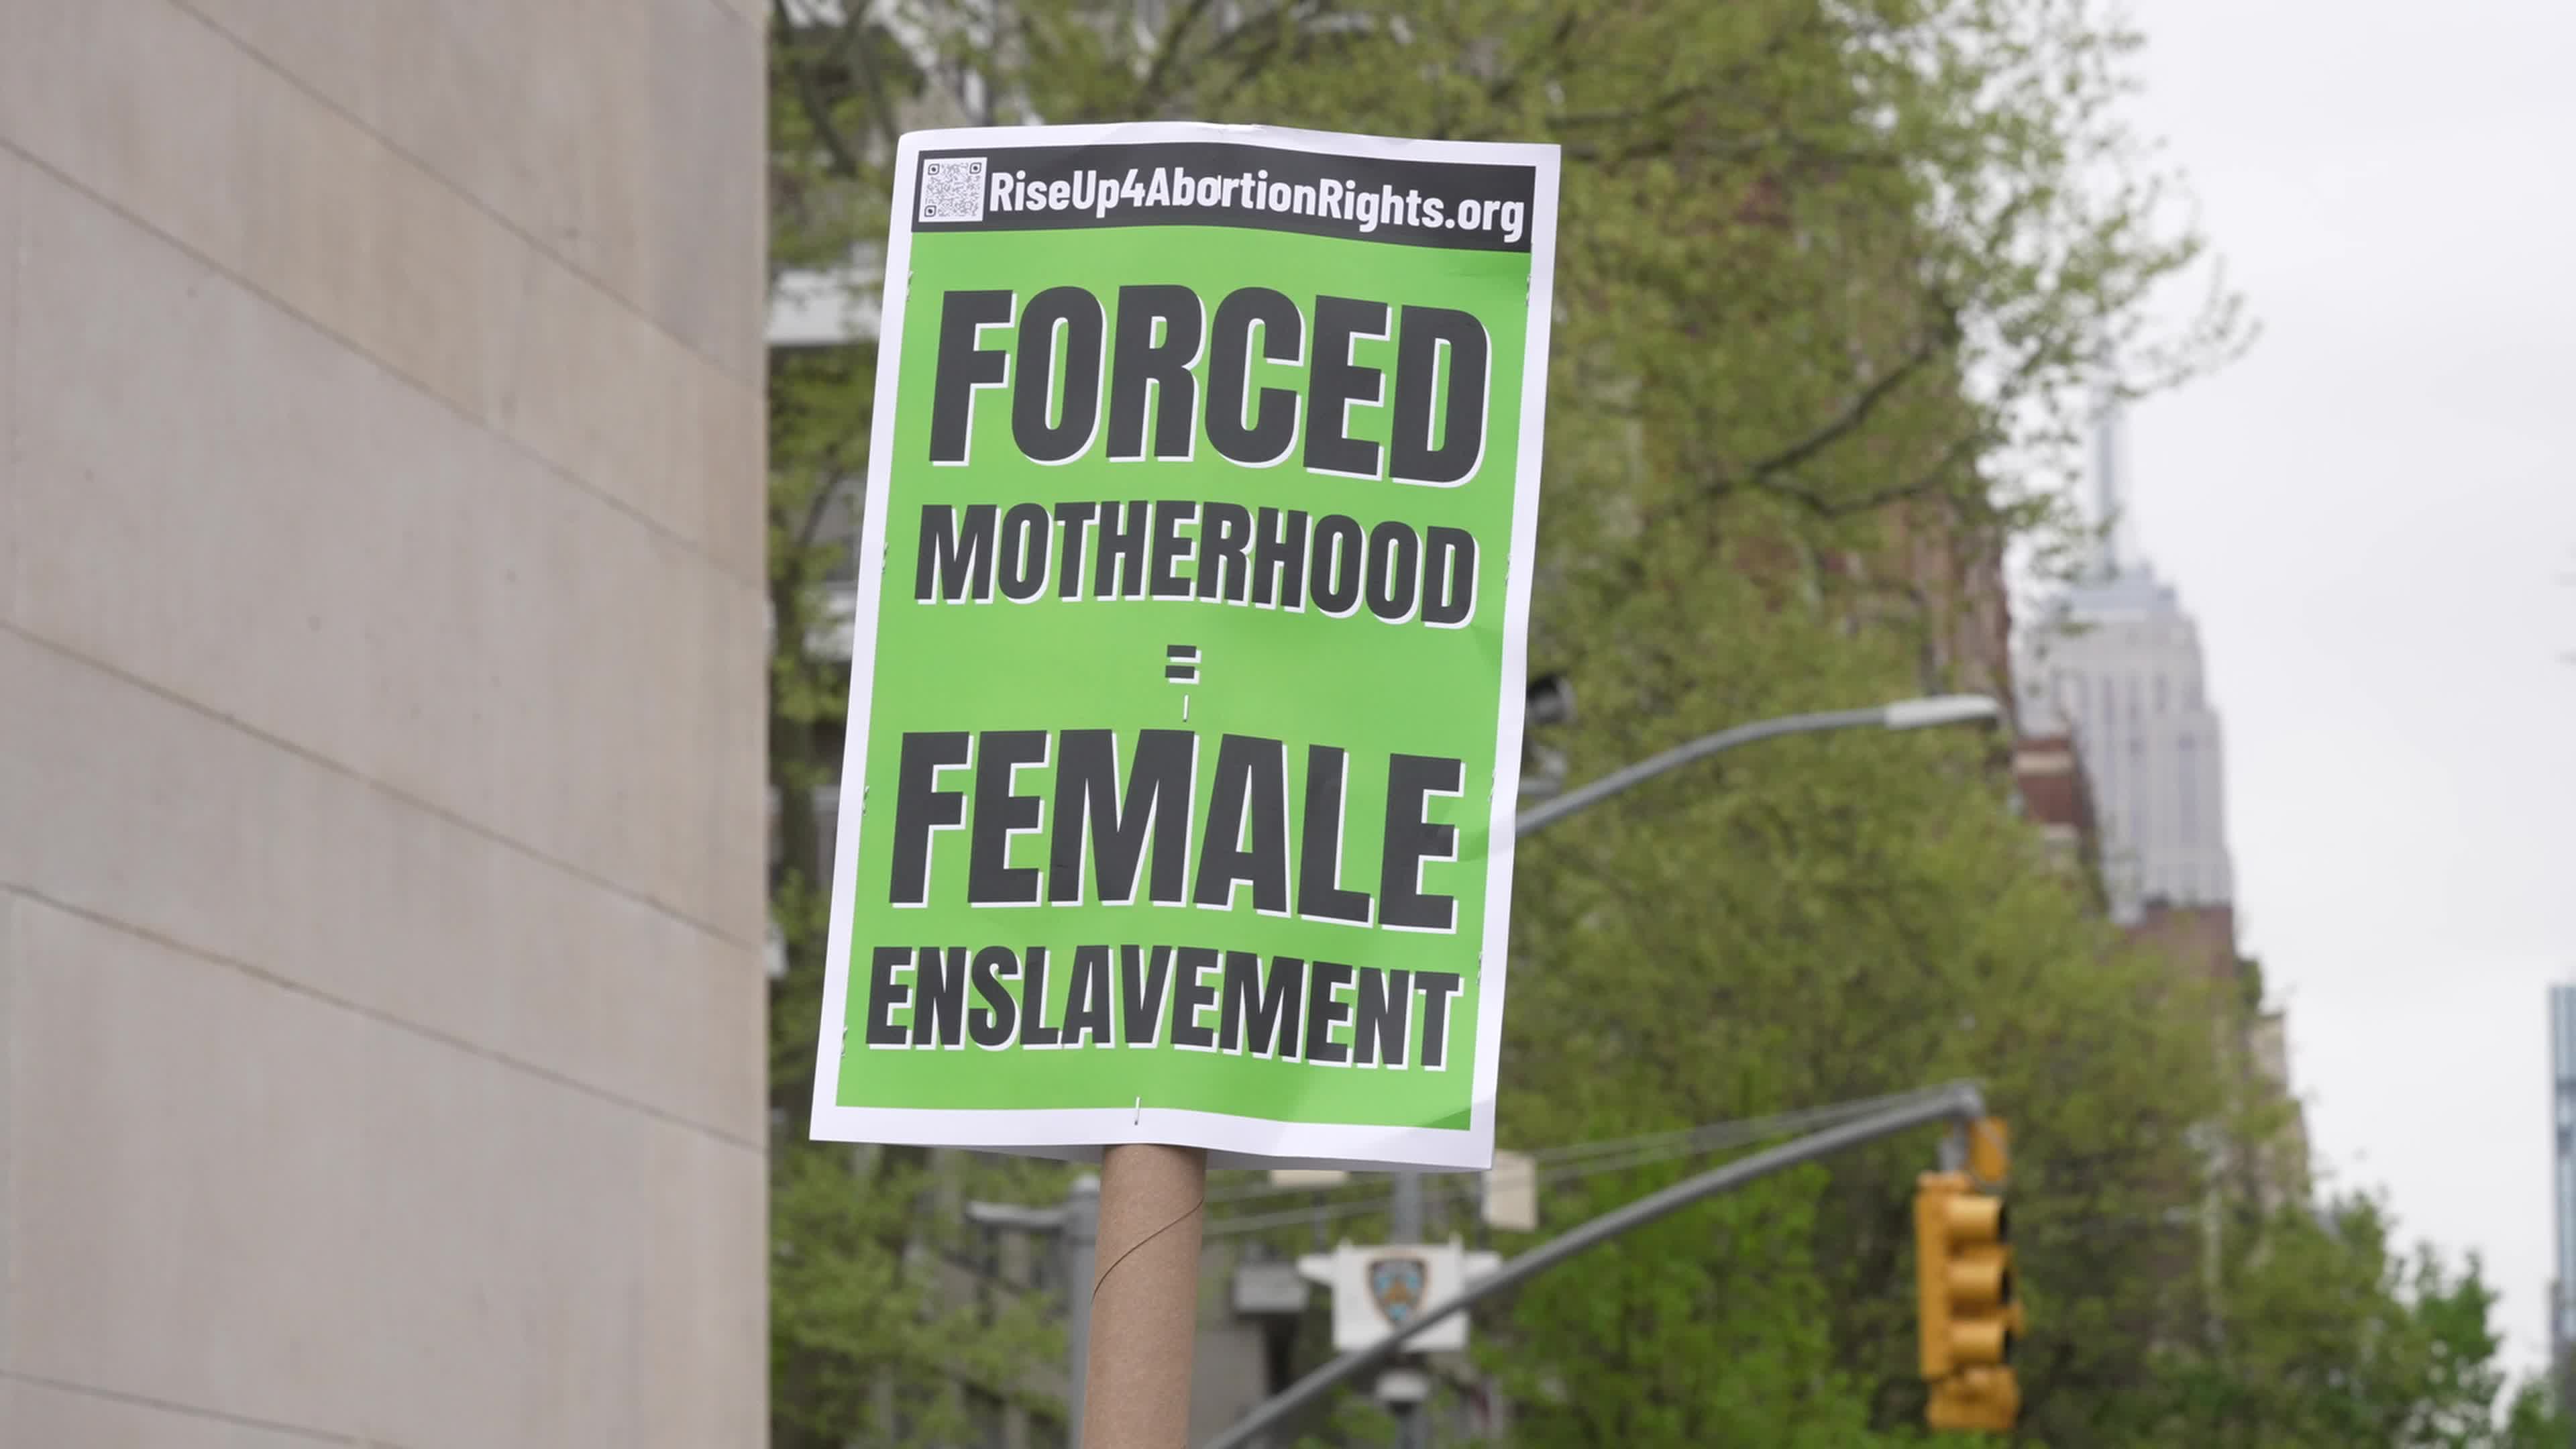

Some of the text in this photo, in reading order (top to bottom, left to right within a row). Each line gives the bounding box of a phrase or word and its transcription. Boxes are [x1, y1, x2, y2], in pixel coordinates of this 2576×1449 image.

[989, 166, 1525, 244] RiseUp4AbortionRights.org
[929, 284, 1493, 488] FORCED
[914, 500, 1481, 630] MOTHERHOOD
[1165, 644, 1202, 685] =
[889, 729, 1467, 934] FEMALE
[865, 945, 1465, 1073] ENSLAVEMENT
